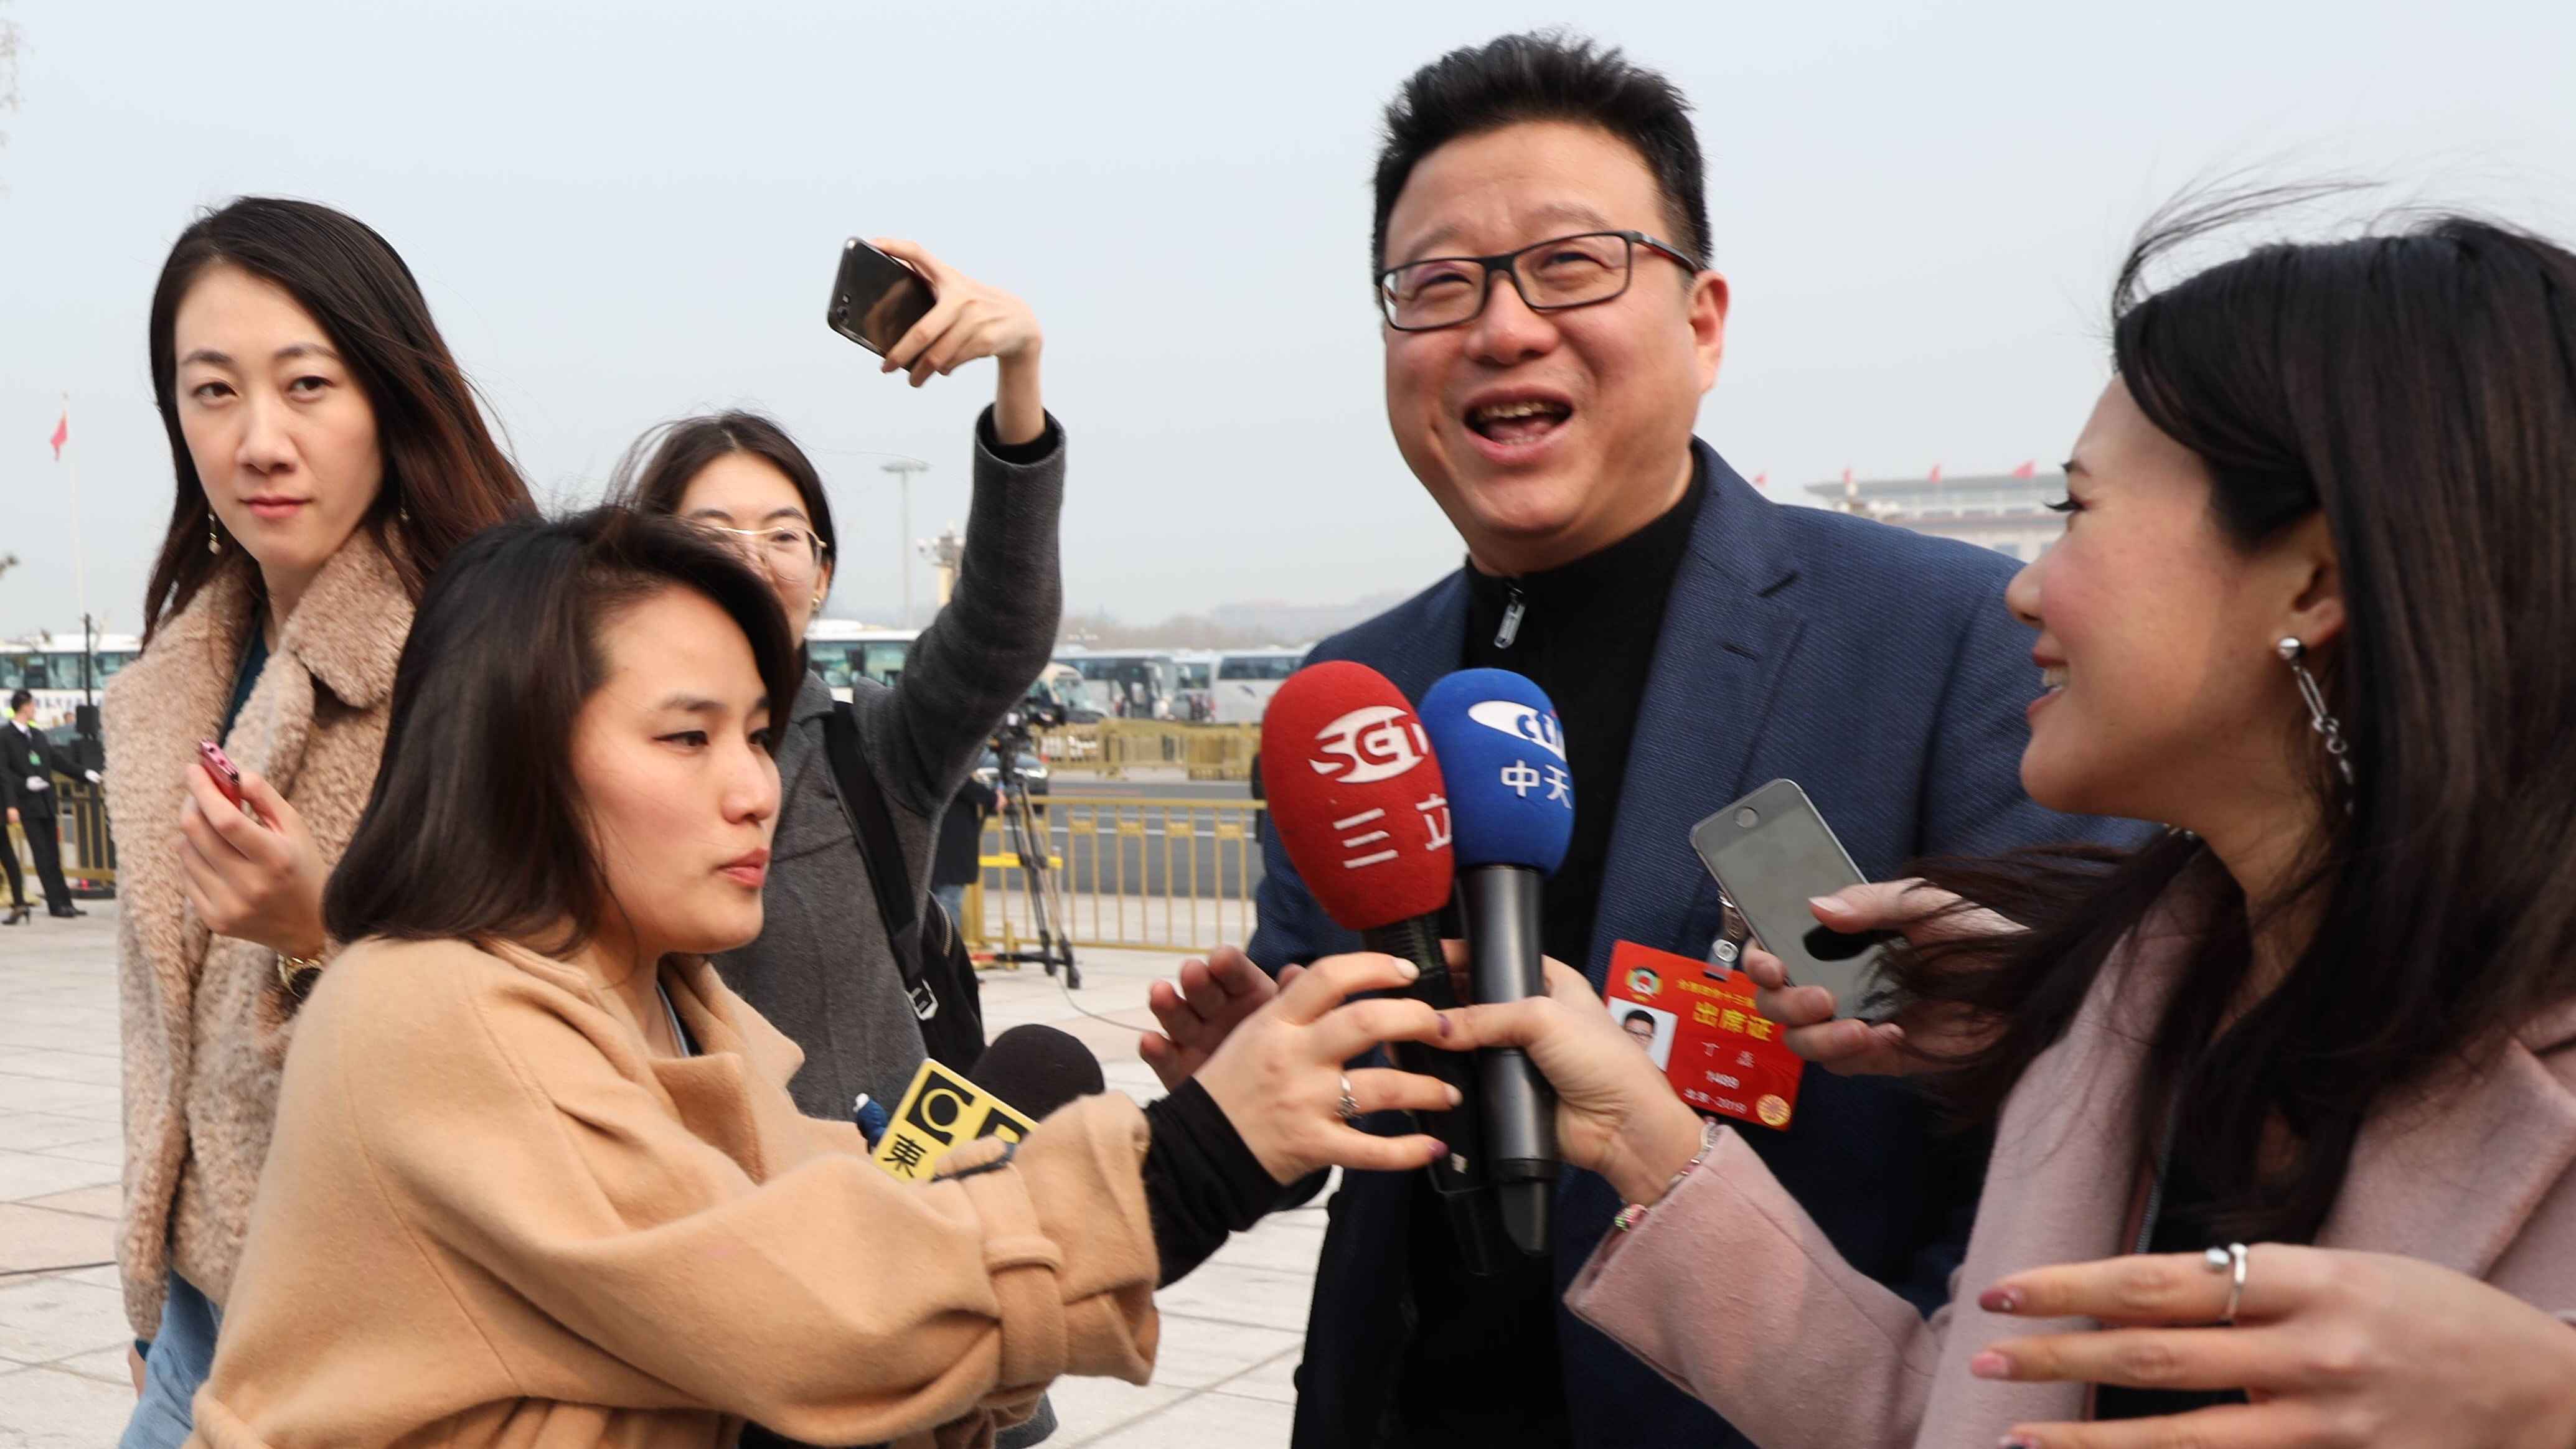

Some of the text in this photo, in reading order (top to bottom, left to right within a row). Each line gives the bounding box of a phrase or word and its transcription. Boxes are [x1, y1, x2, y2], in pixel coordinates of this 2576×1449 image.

[1501, 759, 1572, 809] 中天
[1332, 793, 1452, 869] 三立
[1693, 1001, 1774, 1042] 出席证
